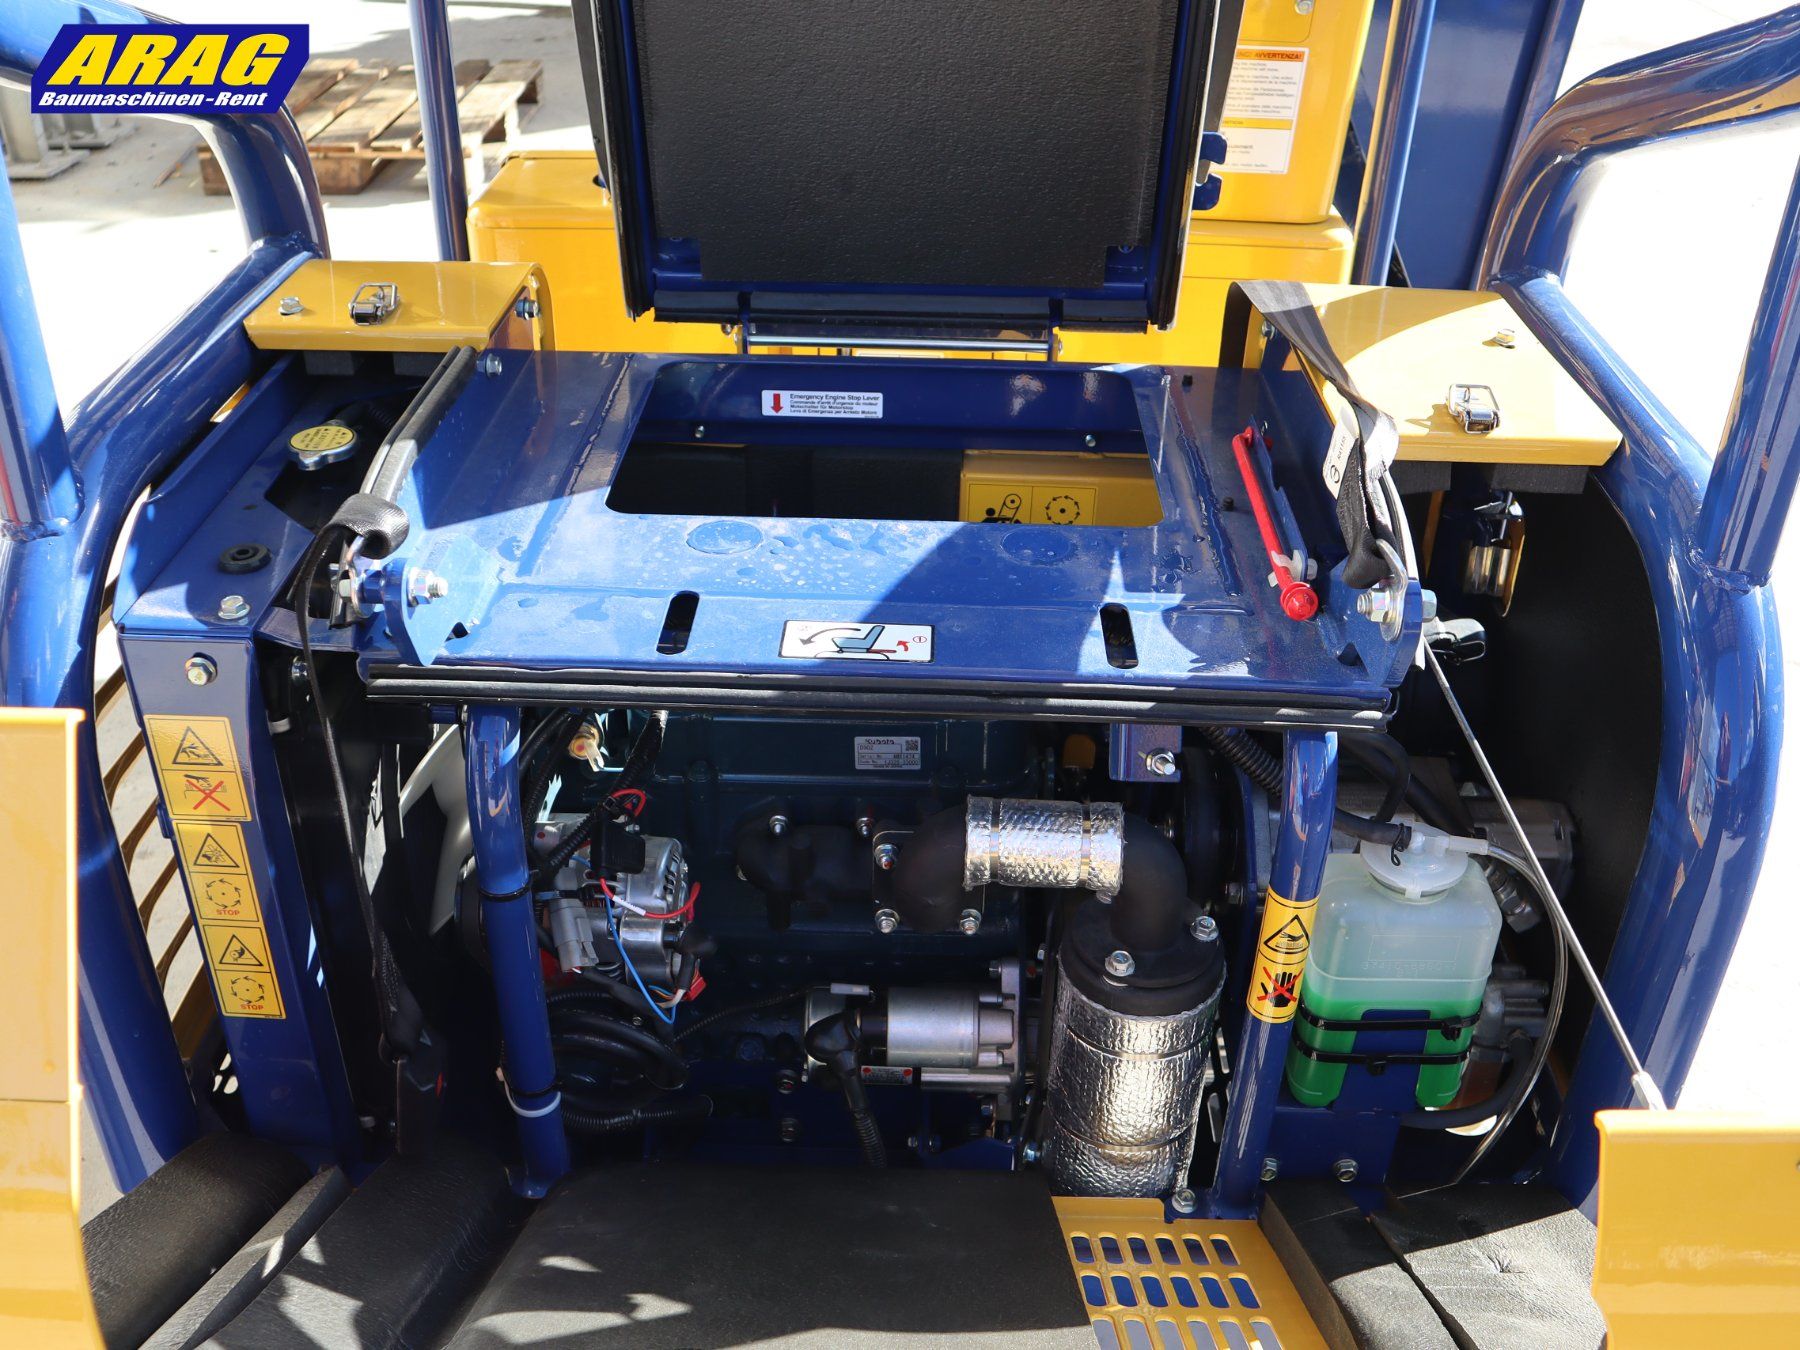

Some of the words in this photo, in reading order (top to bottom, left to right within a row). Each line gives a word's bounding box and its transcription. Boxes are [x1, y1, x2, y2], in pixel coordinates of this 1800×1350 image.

[1254, 52, 1302, 60] AVVERTENZA!
[790, 393, 824, 401] Emergency
[825, 394, 846, 402] Engine
